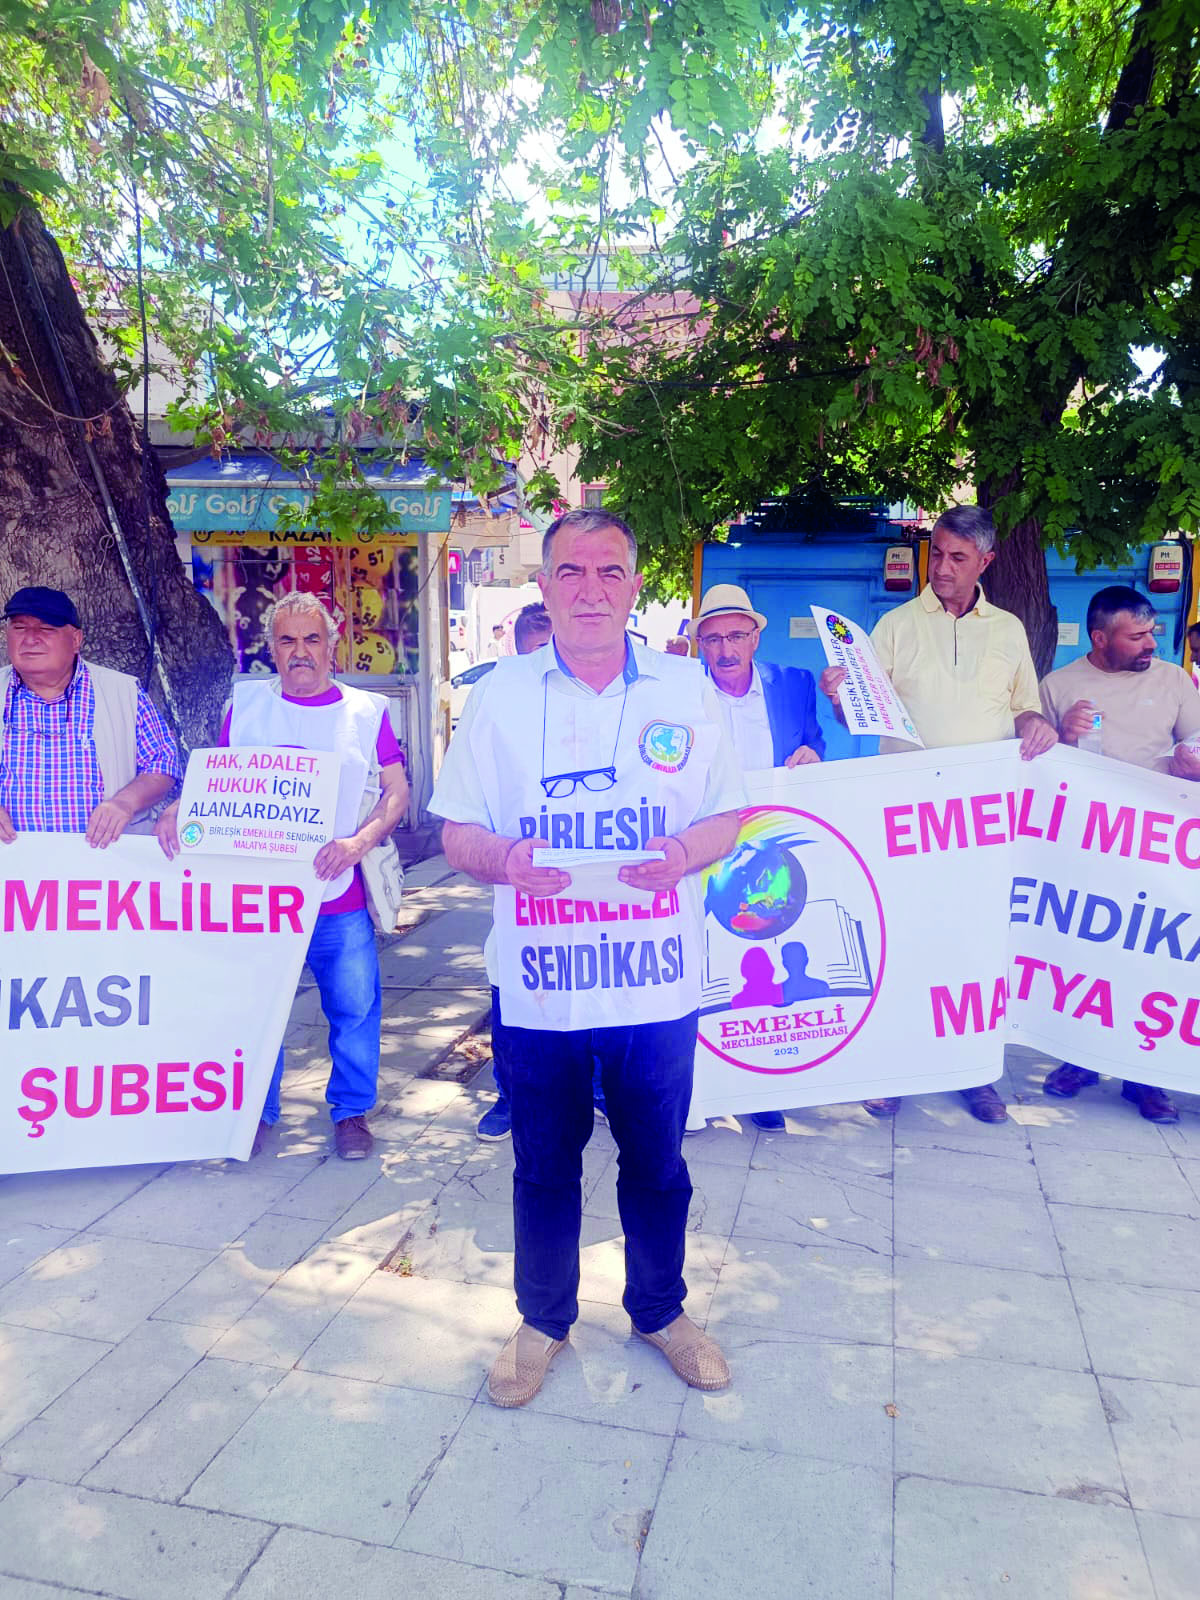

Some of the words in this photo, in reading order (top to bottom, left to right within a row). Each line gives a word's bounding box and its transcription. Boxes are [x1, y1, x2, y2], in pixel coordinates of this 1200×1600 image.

[206, 494, 258, 515] Golf
[390, 495, 443, 518] Golf
[206, 753, 243, 771] HAK,
[247, 753, 320, 777] ADALET,
[207, 777, 268, 794] HUKUK
[272, 775, 312, 800] İÇİN
[188, 801, 324, 825] ALANLARDAYIZ.
[209, 825, 241, 837] BİRLEŞİK
[242, 827, 285, 840] EMEKLİLER
[286, 831, 327, 844] SENDİKASI
[233, 839, 267, 850] MALATYA
[268, 841, 298, 854] ŞUBESİ
[520, 932, 684, 991] SENDİKASI
[0, 975, 151, 1030] KASI
[719, 1003, 846, 1037] EMEKLİ
[720, 1033, 788, 1050] MECLİSLERİ
[790, 1026, 849, 1042] SENDİKASI
[774, 1046, 799, 1056] 2023
[17, 1048, 244, 1138] ŞUBESİ
